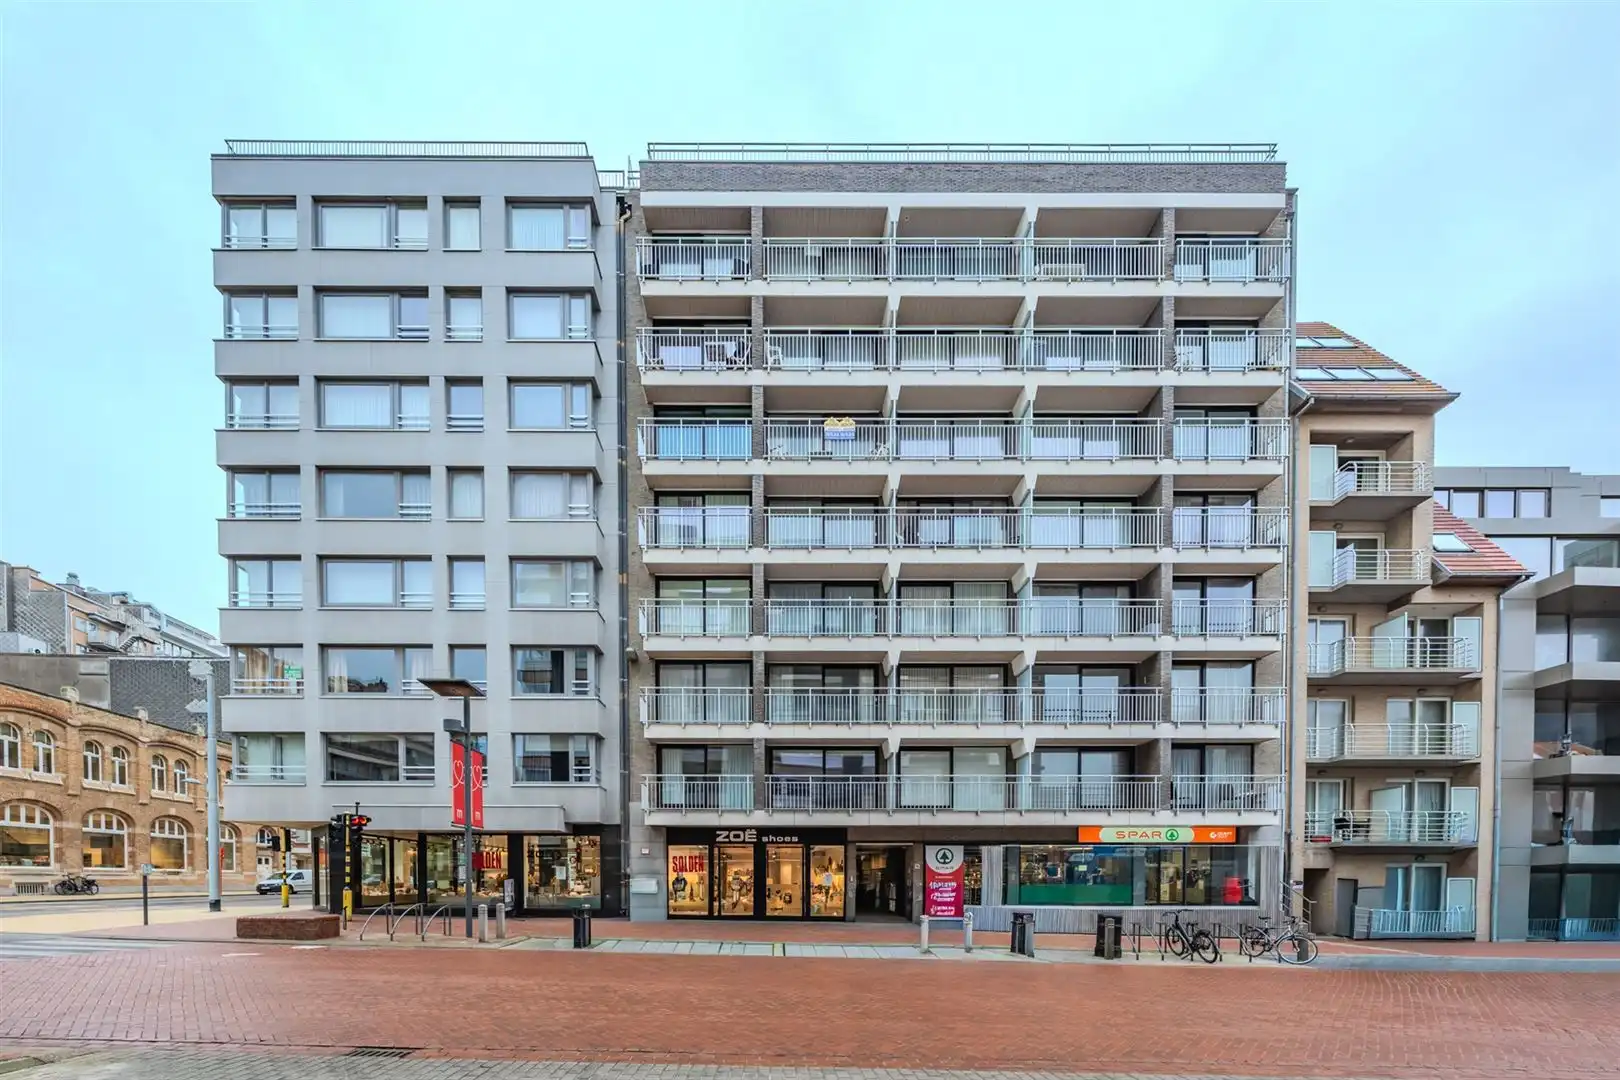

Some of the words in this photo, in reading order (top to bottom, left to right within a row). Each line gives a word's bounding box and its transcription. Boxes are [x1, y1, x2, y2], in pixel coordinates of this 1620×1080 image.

[715, 828, 757, 842] ZOË
[761, 834, 798, 842] shoes
[1115, 830, 1162, 839] SPAR
[672, 855, 705, 873] SOLDEN
